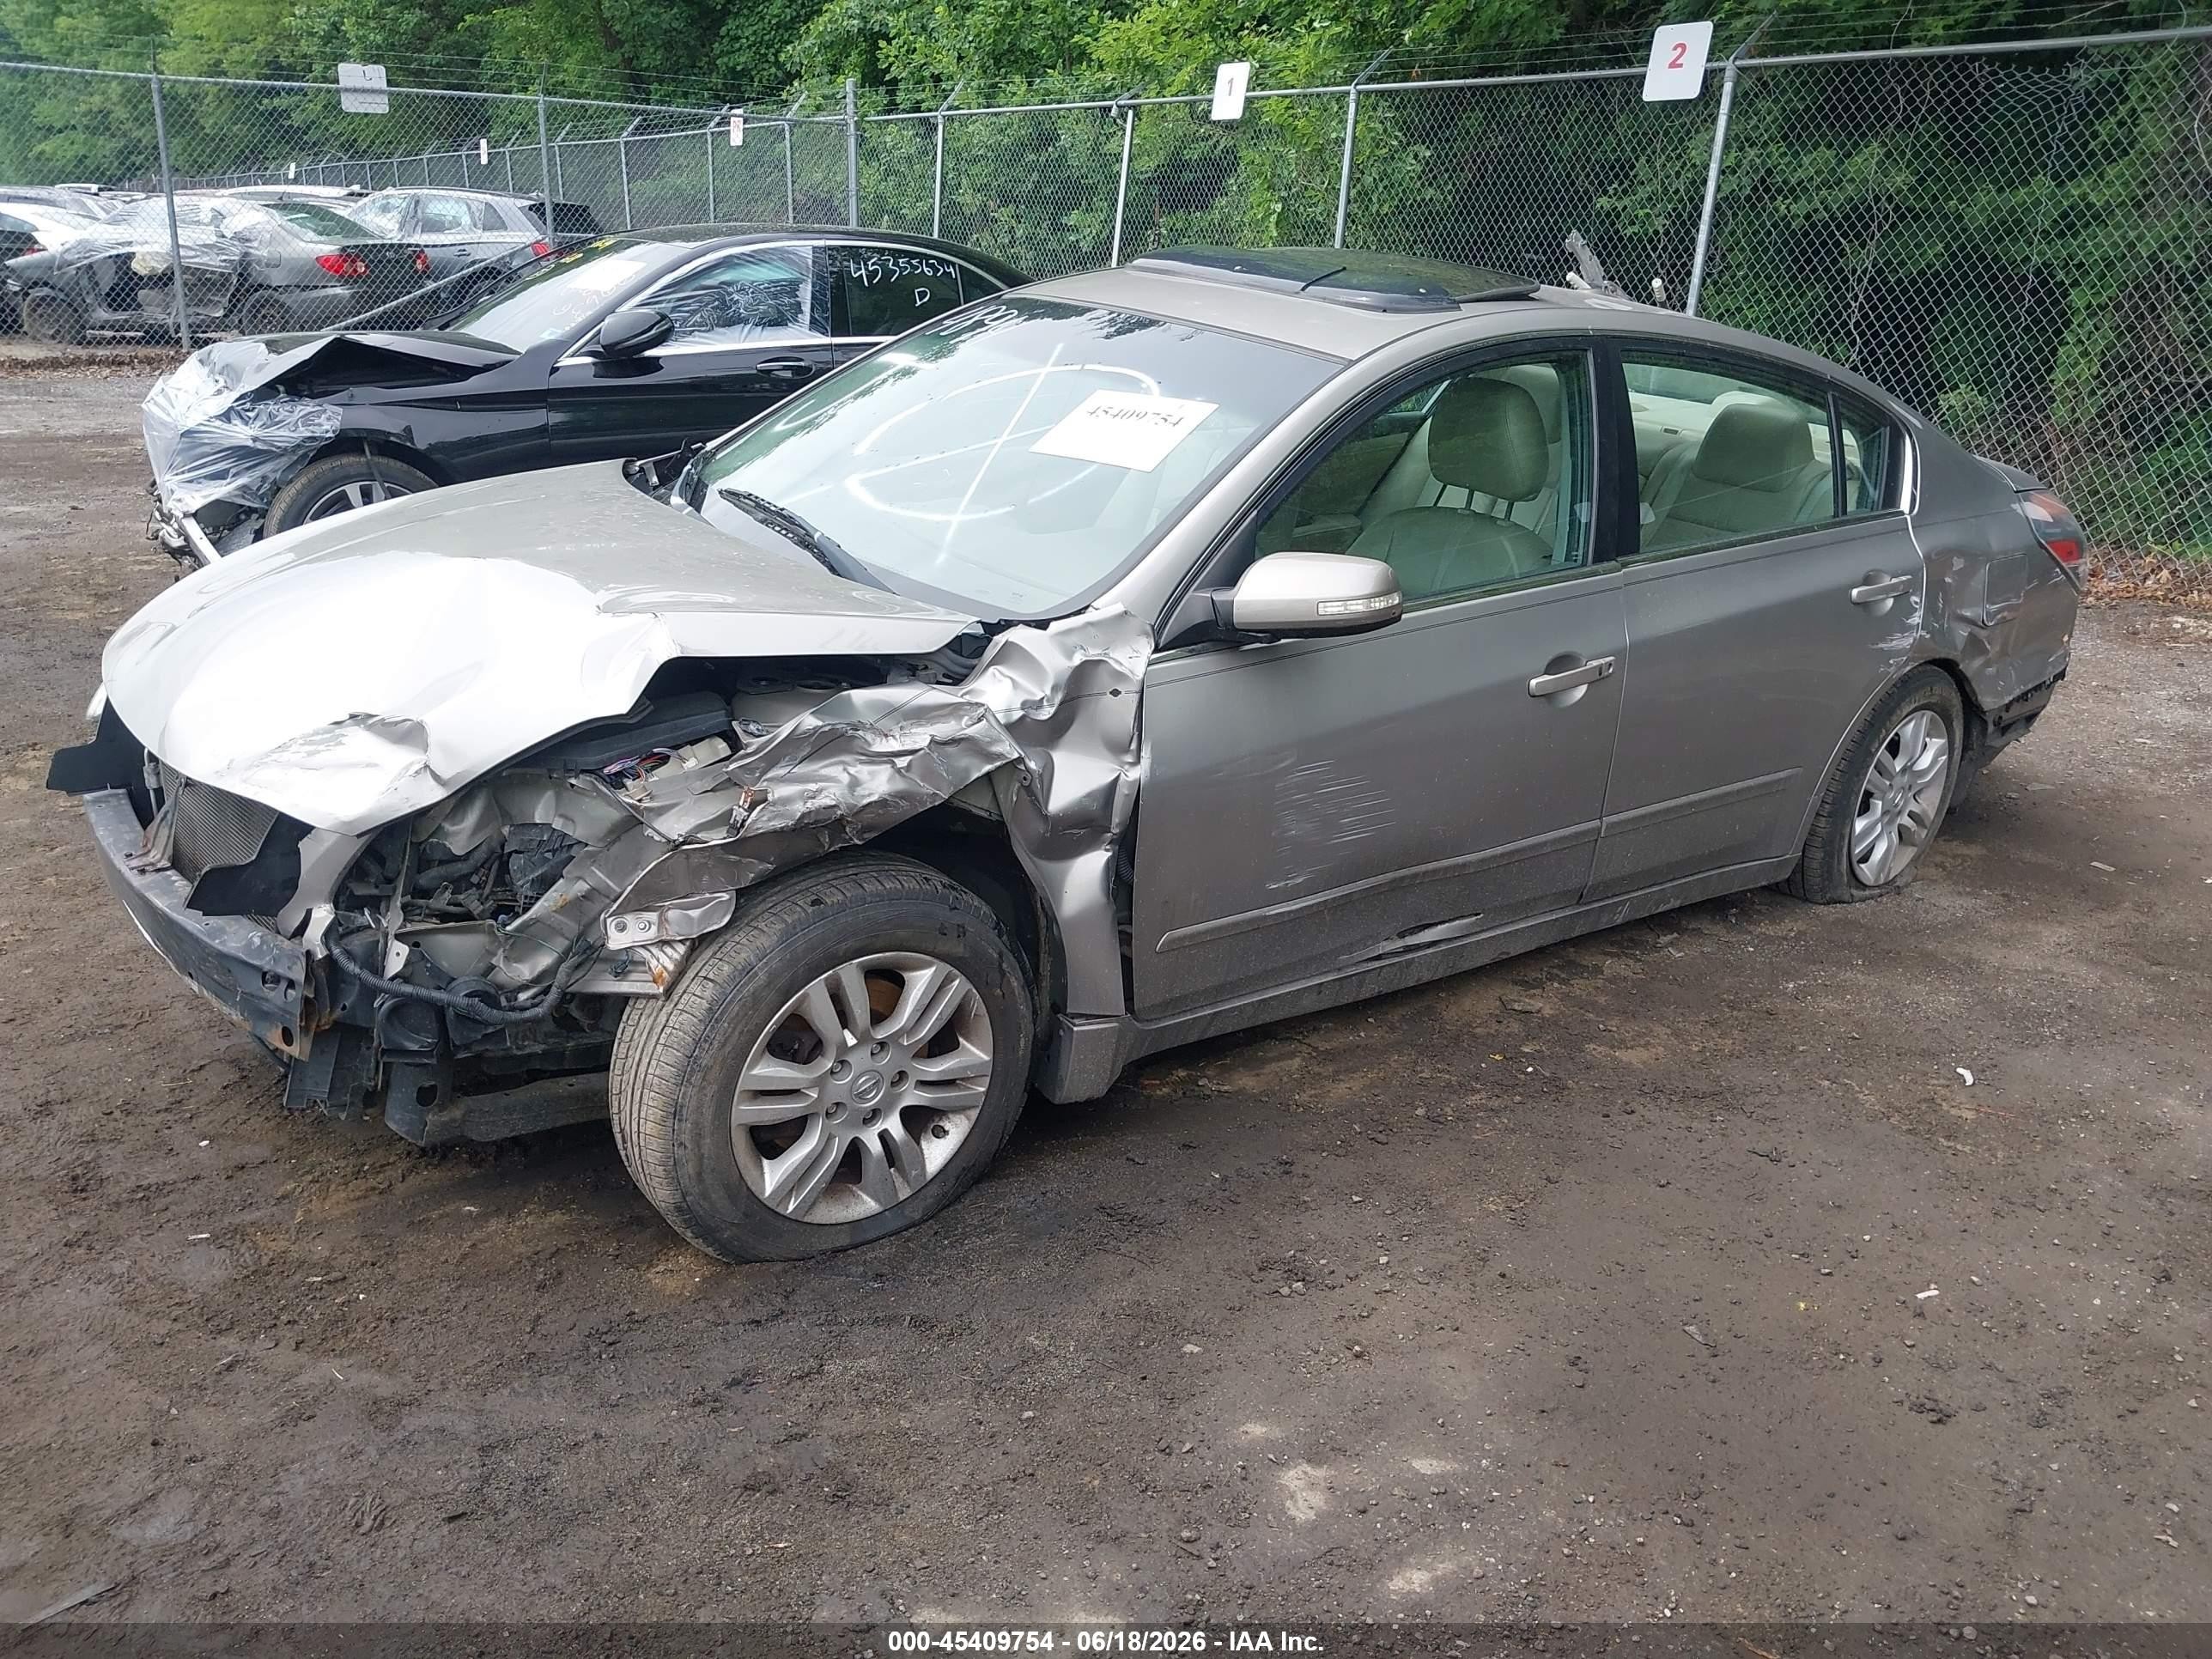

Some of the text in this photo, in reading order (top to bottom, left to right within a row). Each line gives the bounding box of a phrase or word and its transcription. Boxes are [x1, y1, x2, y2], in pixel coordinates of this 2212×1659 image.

[1668, 42, 1688, 70] 2
[1227, 77, 1235, 97] 1
[849, 256, 957, 288] 45355634
[914, 287, 932, 307] D
